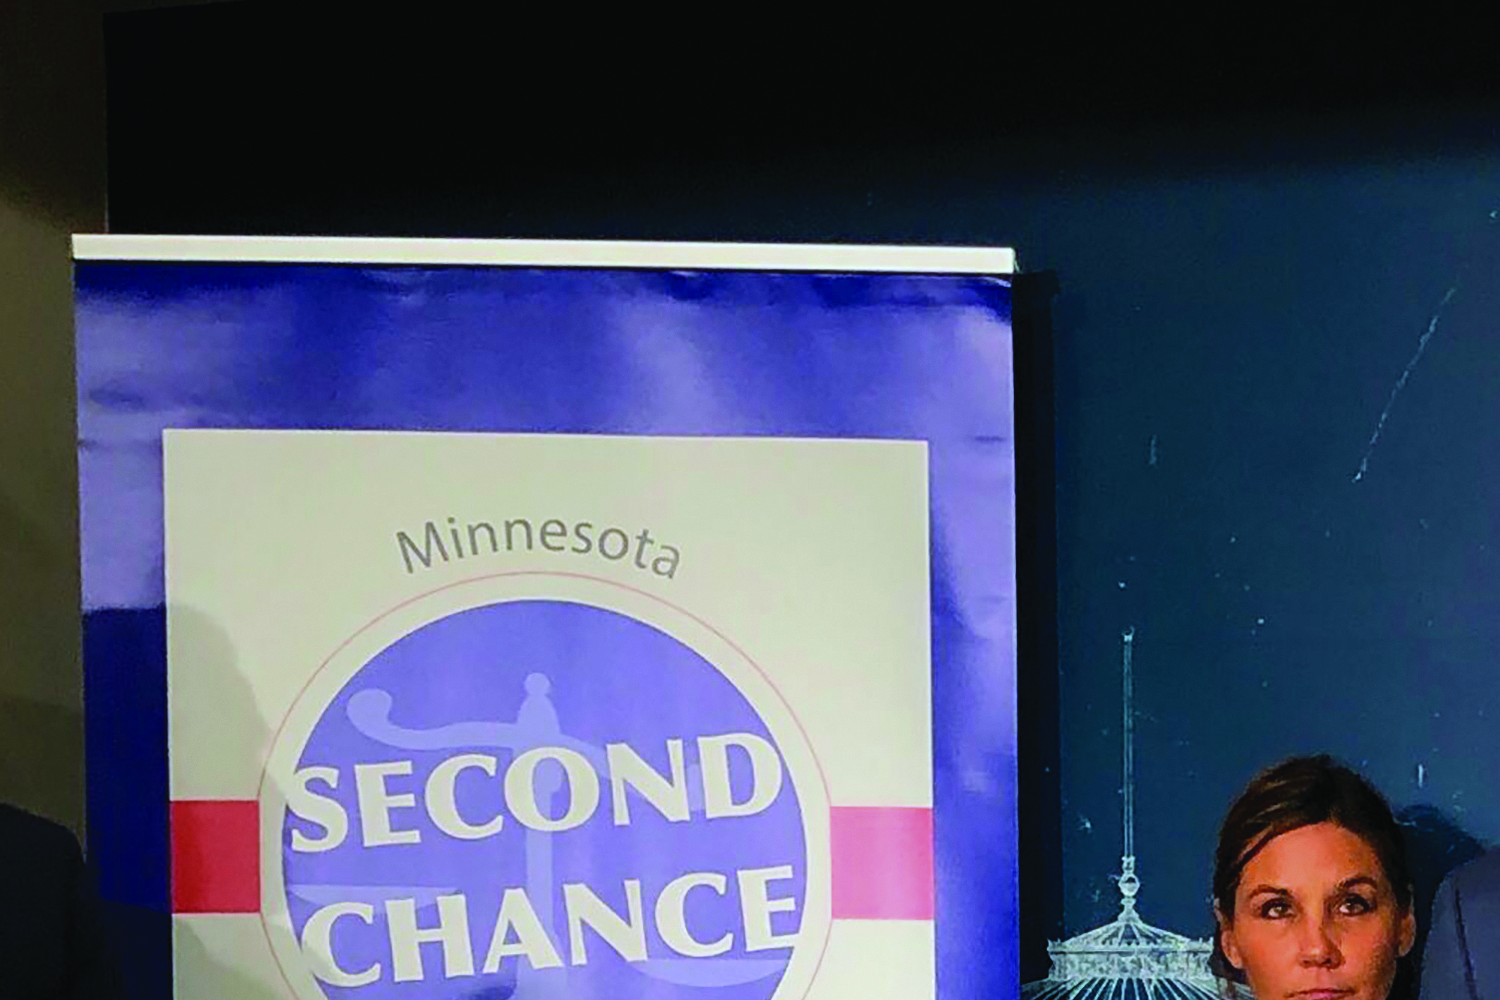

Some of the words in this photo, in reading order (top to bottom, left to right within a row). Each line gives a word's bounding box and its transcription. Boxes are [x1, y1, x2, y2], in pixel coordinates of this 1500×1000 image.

[396, 516, 681, 580] Minnesota
[286, 733, 783, 852] SECOND
[300, 865, 799, 988] CHANCE
